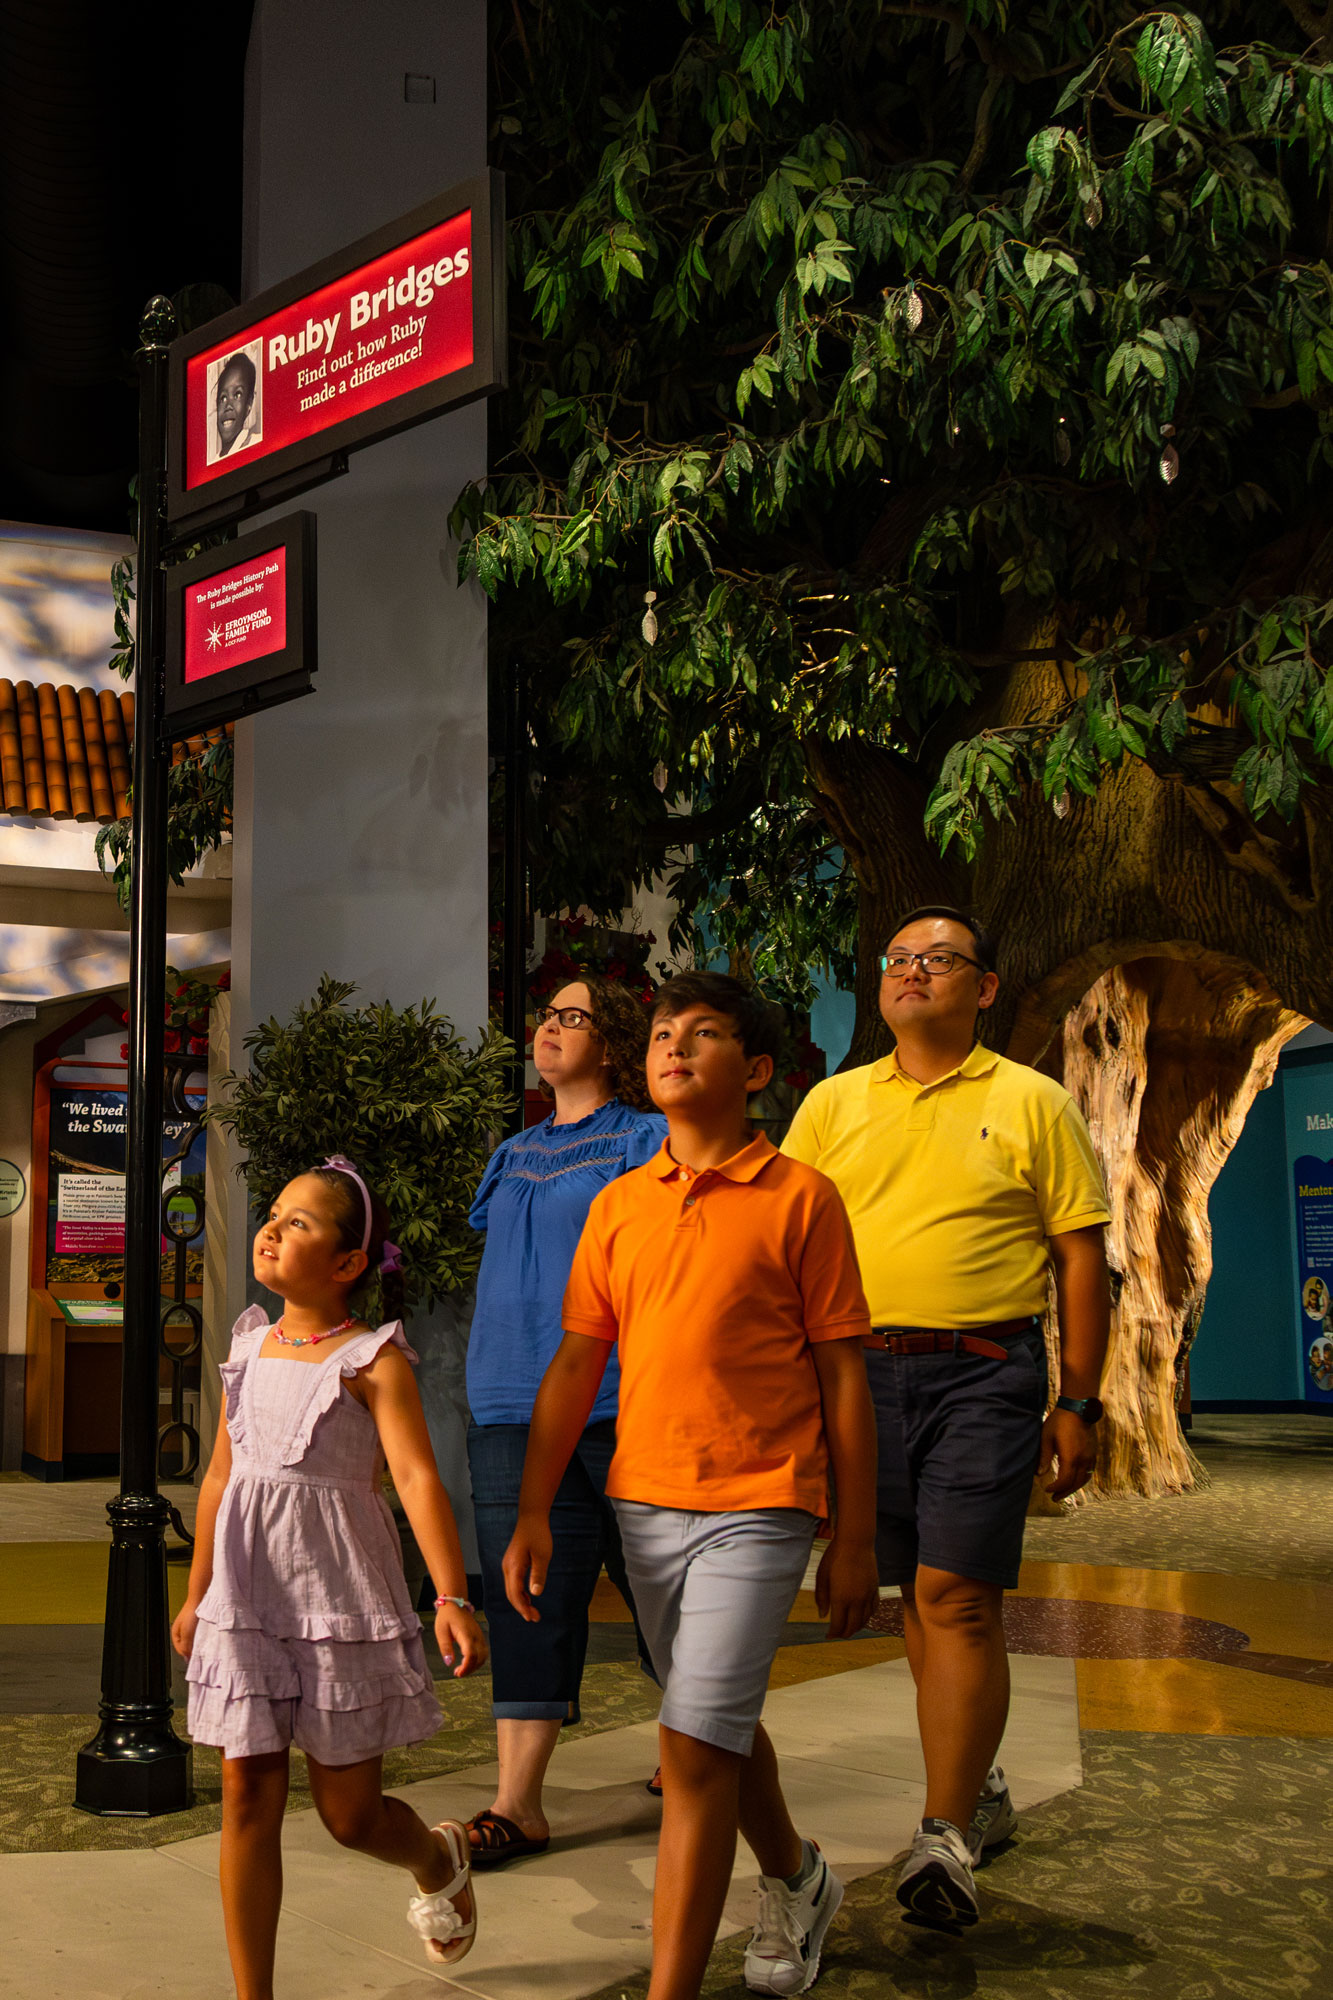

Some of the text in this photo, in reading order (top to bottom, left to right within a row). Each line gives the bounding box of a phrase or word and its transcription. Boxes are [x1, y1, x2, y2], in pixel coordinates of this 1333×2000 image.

[269, 247, 470, 372] Ruby Bridges
[297, 315, 427, 389] Find out how Ruby
[300, 338, 422, 412] made a difference!
[196, 562, 279, 604] The Ruby Bridges History Path
[210, 583, 264, 610] is made possible by:
[225, 608, 268, 632] EFROYMSON
[225, 616, 272, 640] FAMILY FUND
[91, 1103, 124, 1116] lived
[68, 1120, 90, 1133] the
